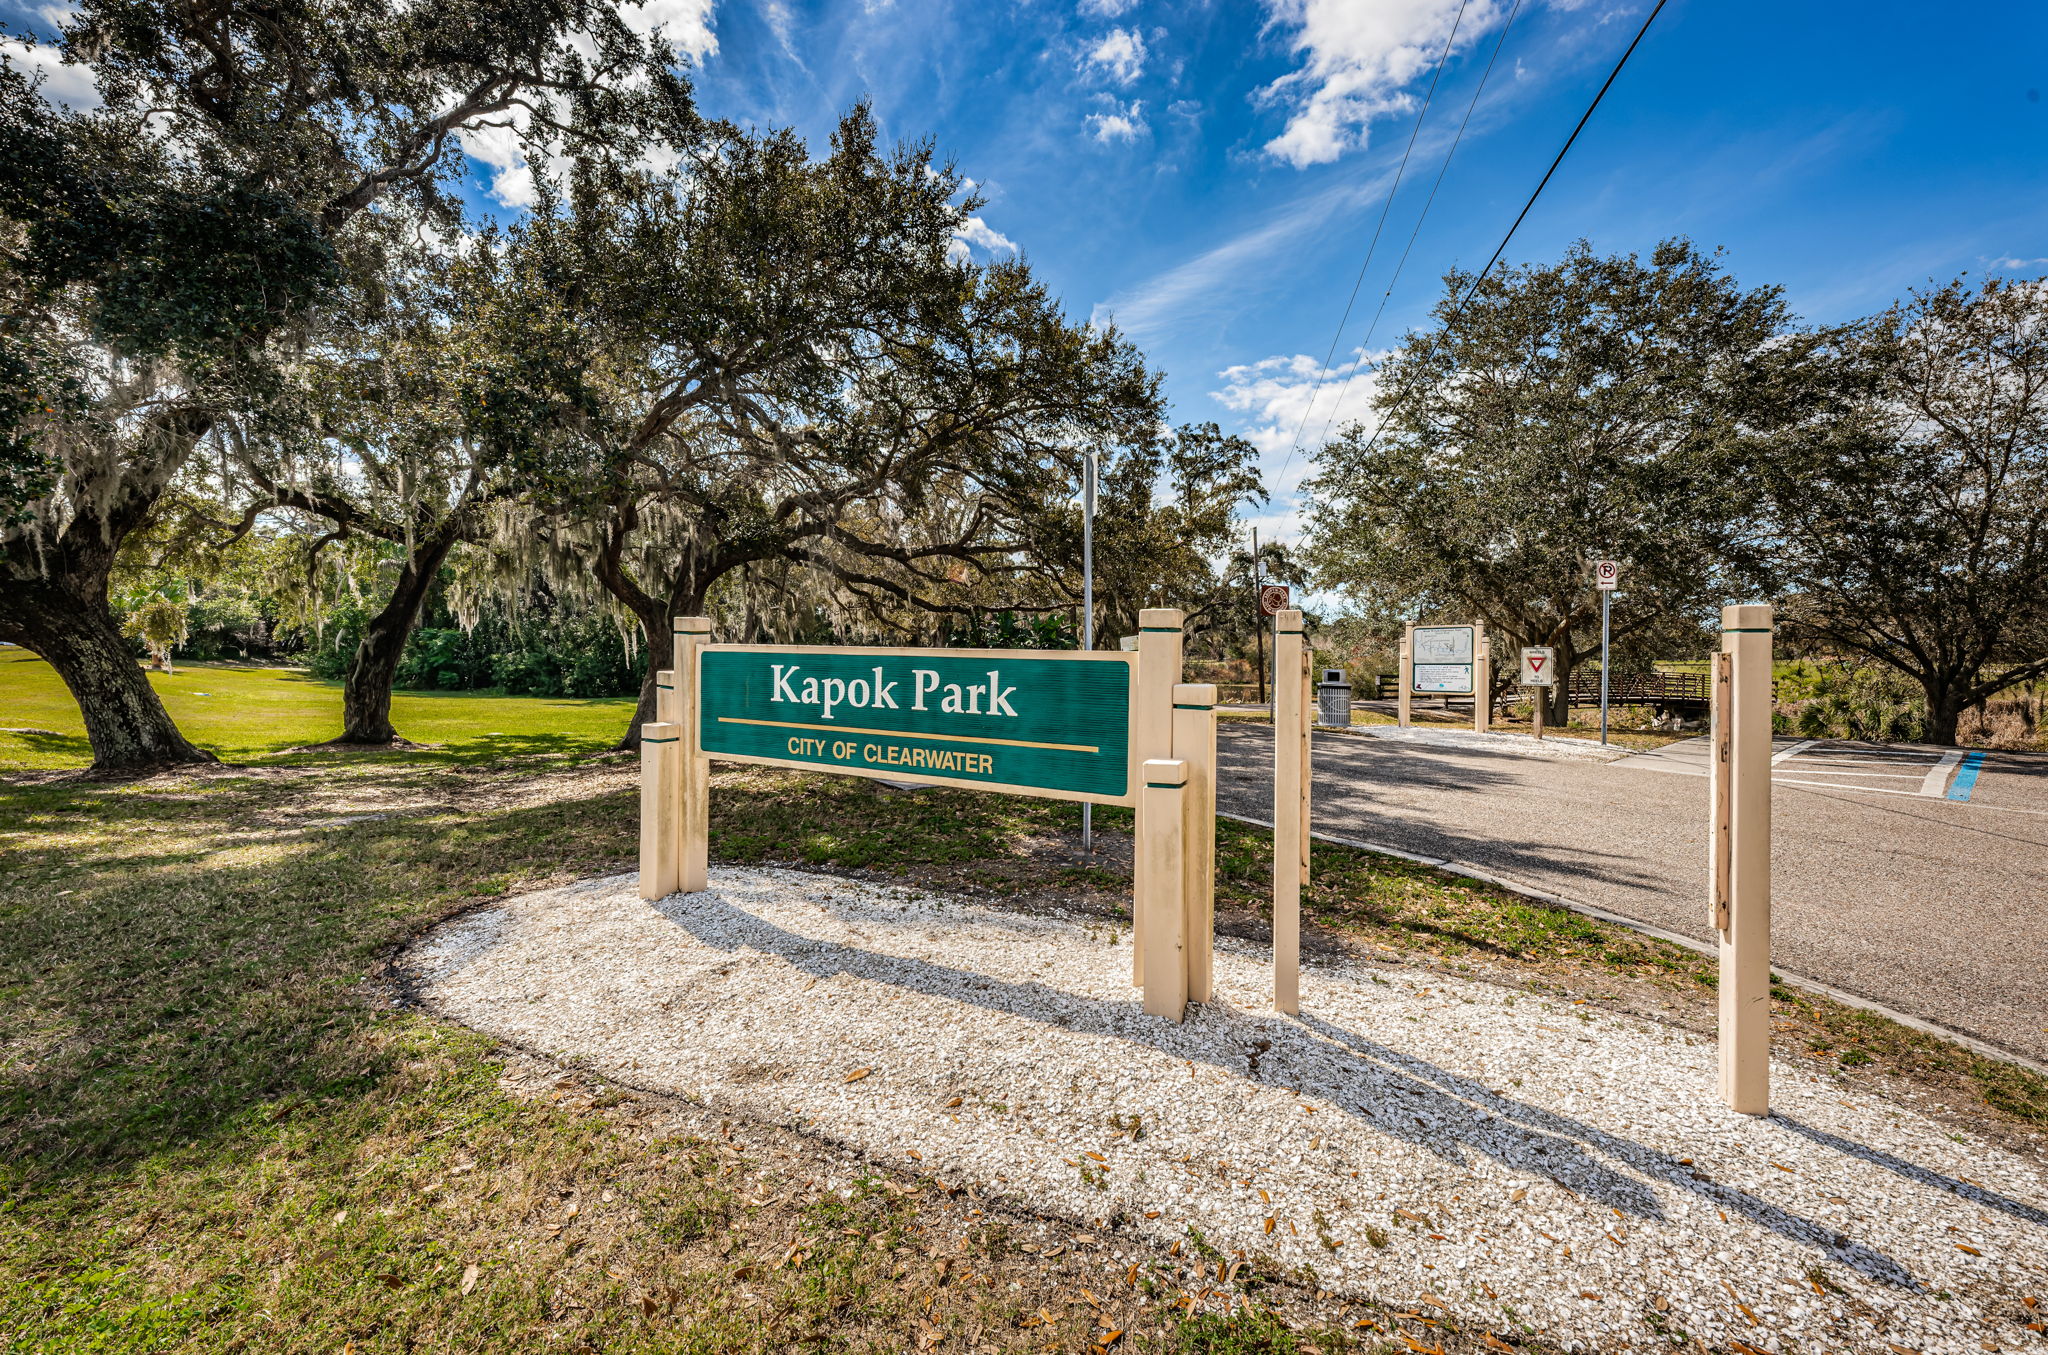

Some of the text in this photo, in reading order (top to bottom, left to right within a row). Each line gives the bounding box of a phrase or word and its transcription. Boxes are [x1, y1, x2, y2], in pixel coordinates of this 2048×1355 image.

[770, 664, 1018, 719] Kapok Park
[787, 736, 993, 774] CITY OF CLEARWATER
